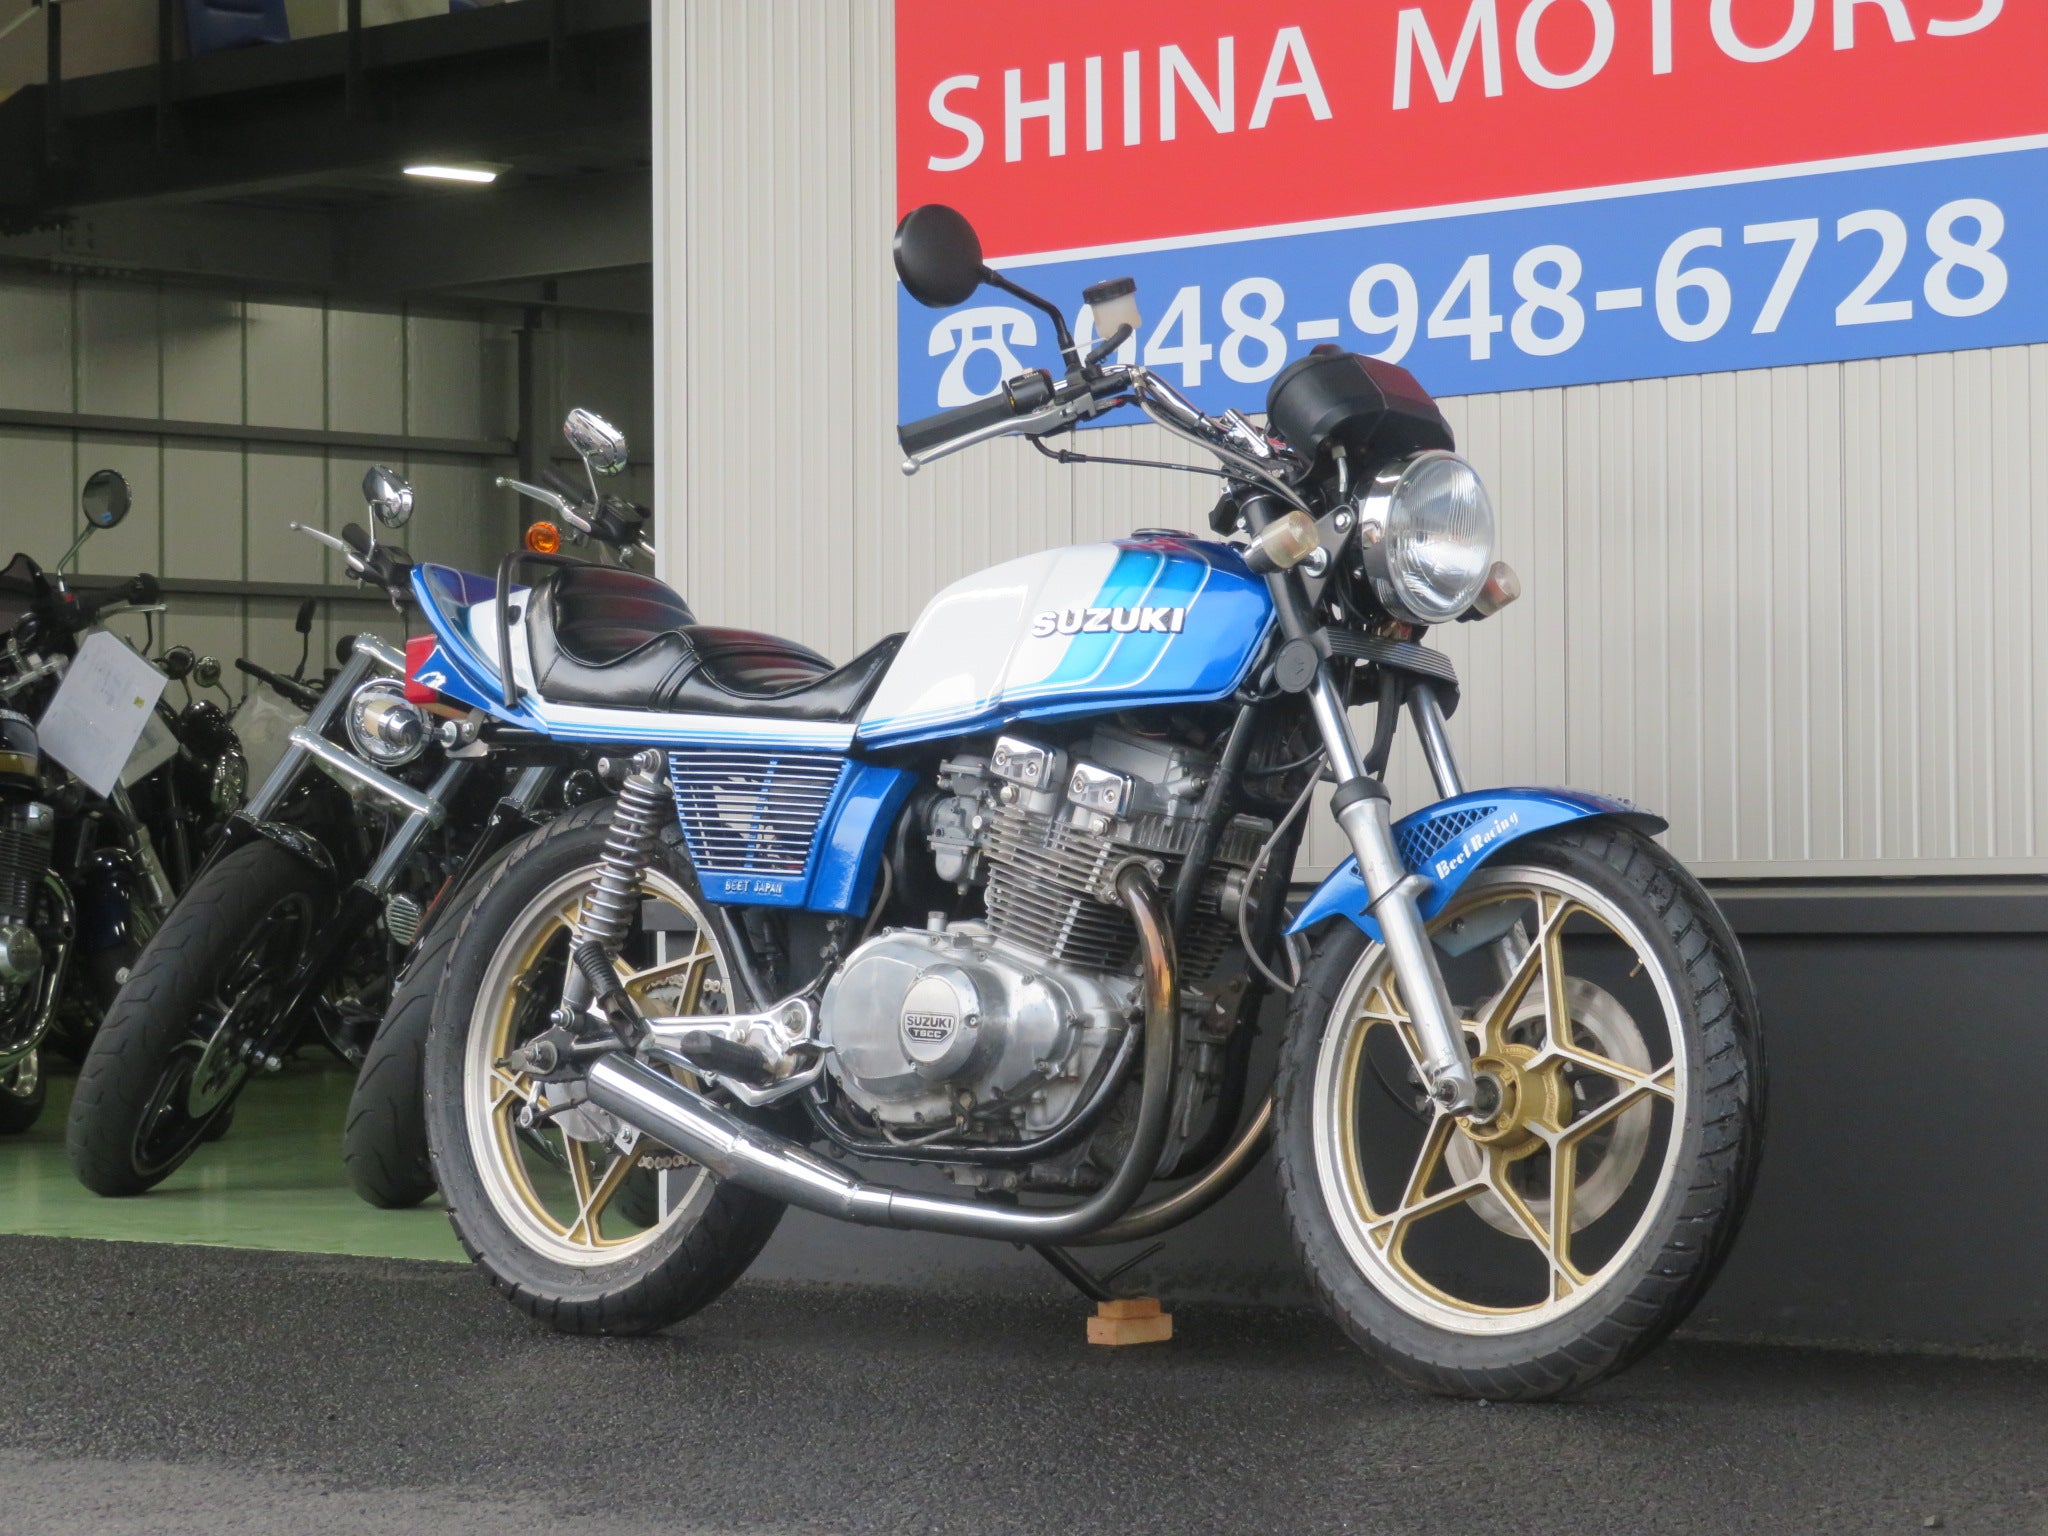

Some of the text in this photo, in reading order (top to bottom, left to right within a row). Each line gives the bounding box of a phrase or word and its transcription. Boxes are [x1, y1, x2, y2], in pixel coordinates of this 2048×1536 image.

[928, 26, 1332, 171] SHIINA
[1031, 607, 1186, 638] SUZUKI
[1435, 812, 1519, 880] Beet Racing
[725, 880, 783, 895] BEET JAPAN
[906, 1015, 952, 1029] SUZUKI
